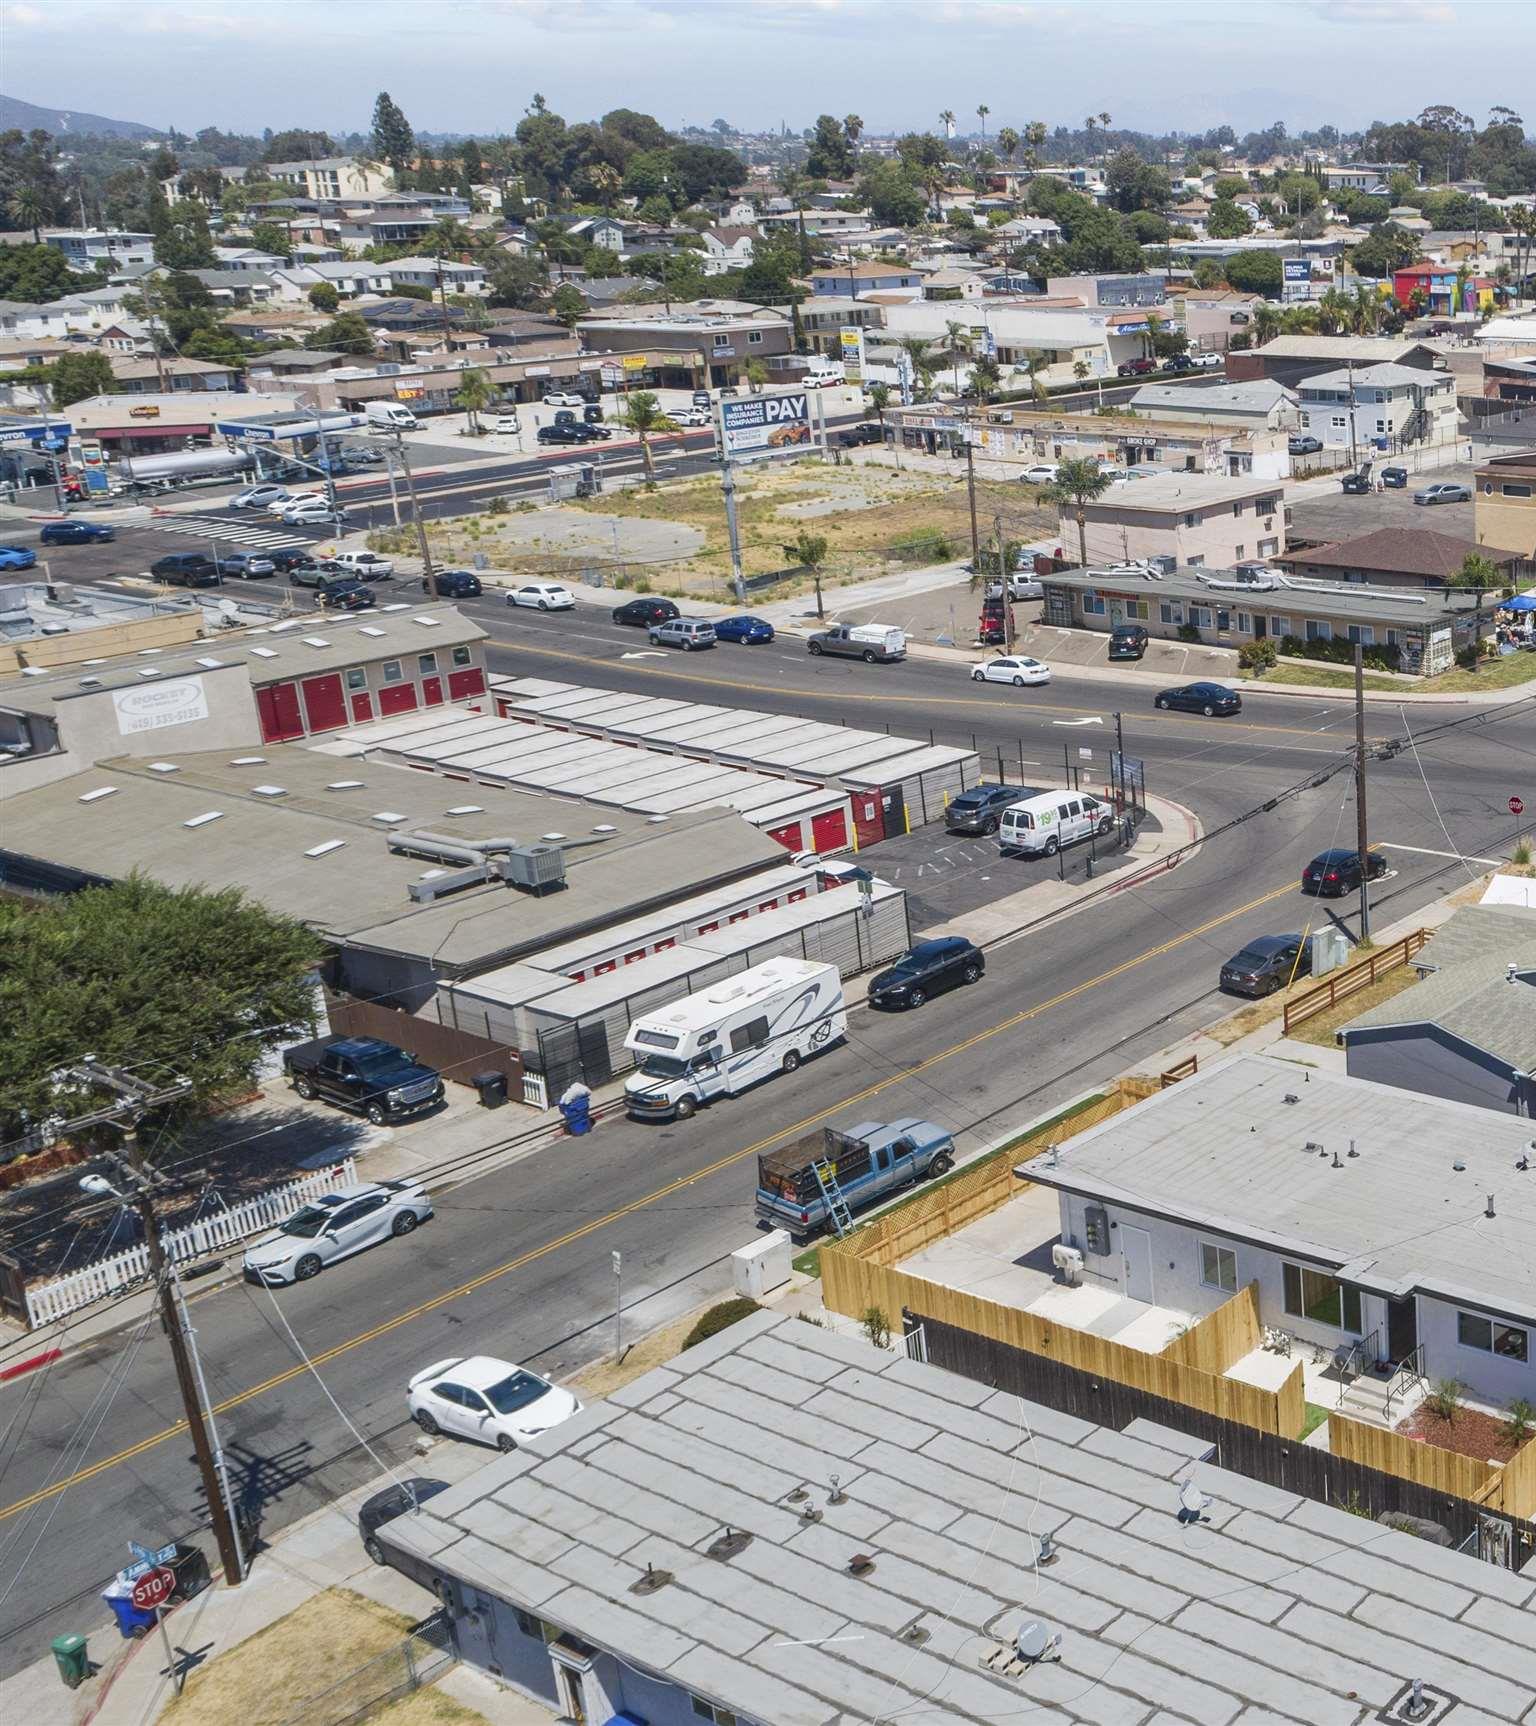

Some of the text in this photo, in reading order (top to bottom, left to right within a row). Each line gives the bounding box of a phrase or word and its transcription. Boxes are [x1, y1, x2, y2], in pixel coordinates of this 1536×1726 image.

[731, 401, 763, 412] WE MAKE
[765, 396, 805, 422] PAY
[726, 409, 764, 420] INSURANCE
[727, 416, 764, 427] COMPANIES
[132, 688, 187, 705] ROCKET
[135, 1573, 171, 1601] STOP
